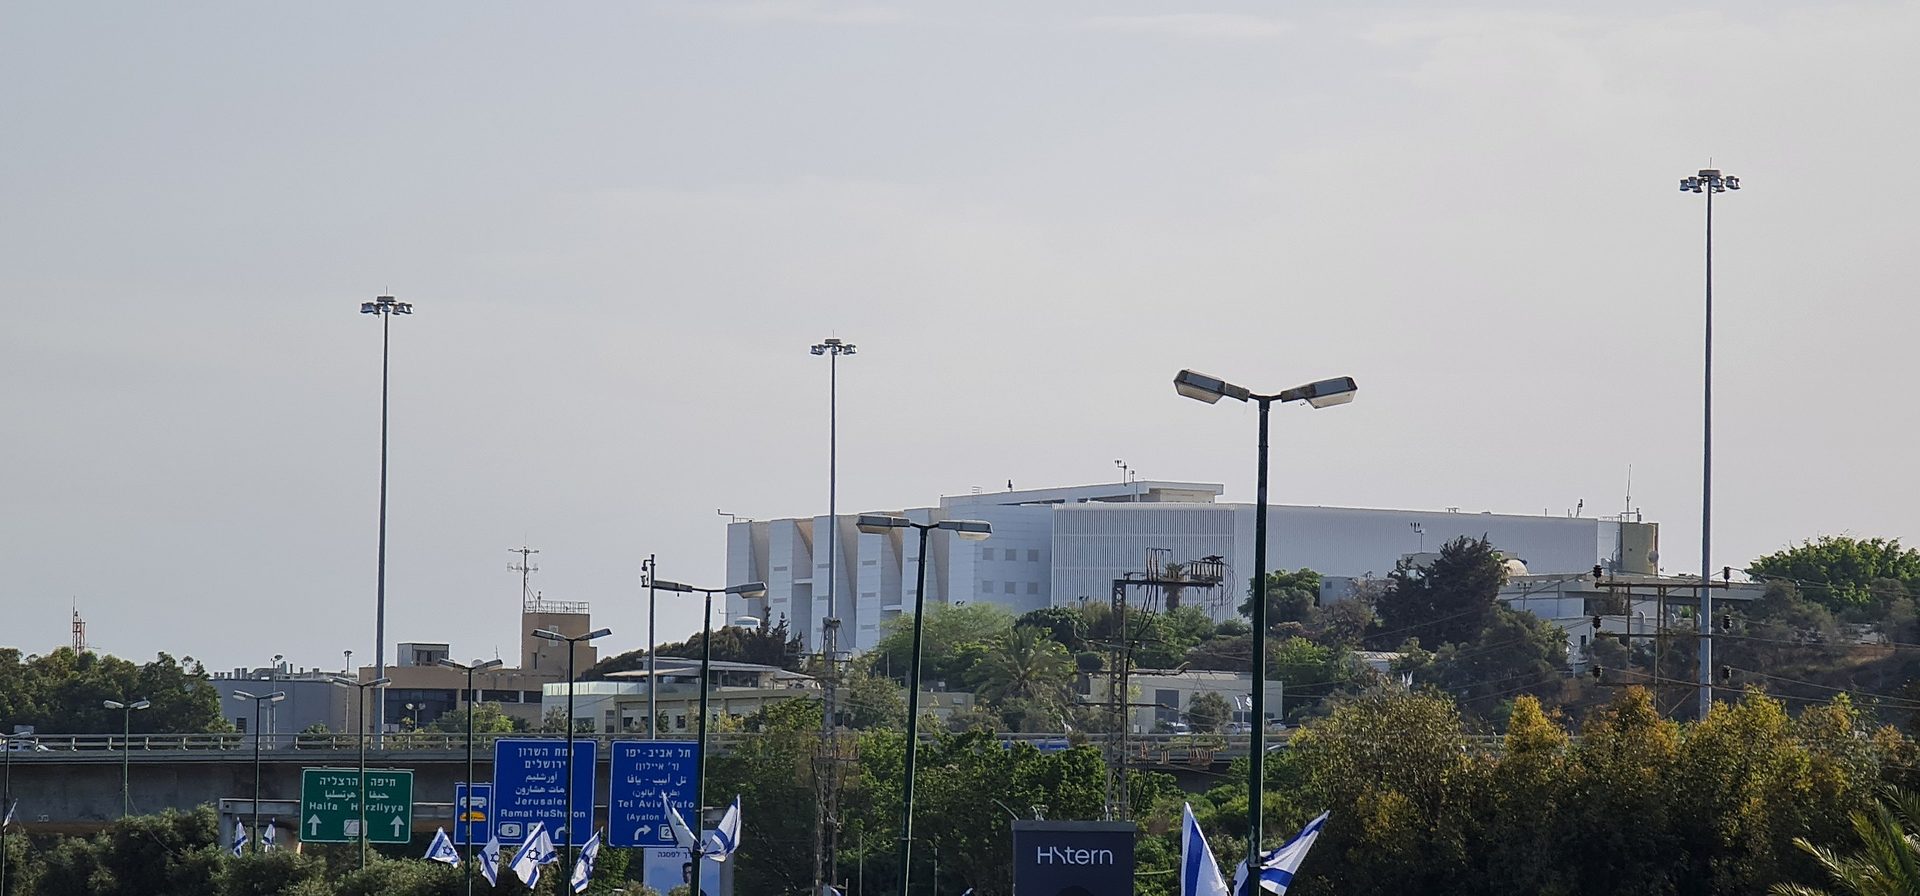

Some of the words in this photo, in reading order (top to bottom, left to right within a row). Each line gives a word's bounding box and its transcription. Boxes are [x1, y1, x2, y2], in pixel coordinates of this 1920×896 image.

[518, 747, 548, 758] השרון
[677, 748, 691, 758] תל
[524, 759, 566, 769] ירושלים
[319, 776, 358, 786] הרצליה
[370, 778, 396, 787] חיפה
[368, 790, 390, 800] حيفا
[309, 801, 338, 811] Haifa
[350, 802, 404, 813] Hrzliyya
[617, 799, 633, 808] Tel
[638, 799, 662, 808] Aviv
[670, 799, 695, 809] Yafo
[500, 809, 533, 818] Ramat
[626, 813, 660, 822] (Ayalon
[507, 826, 514, 834] 5
